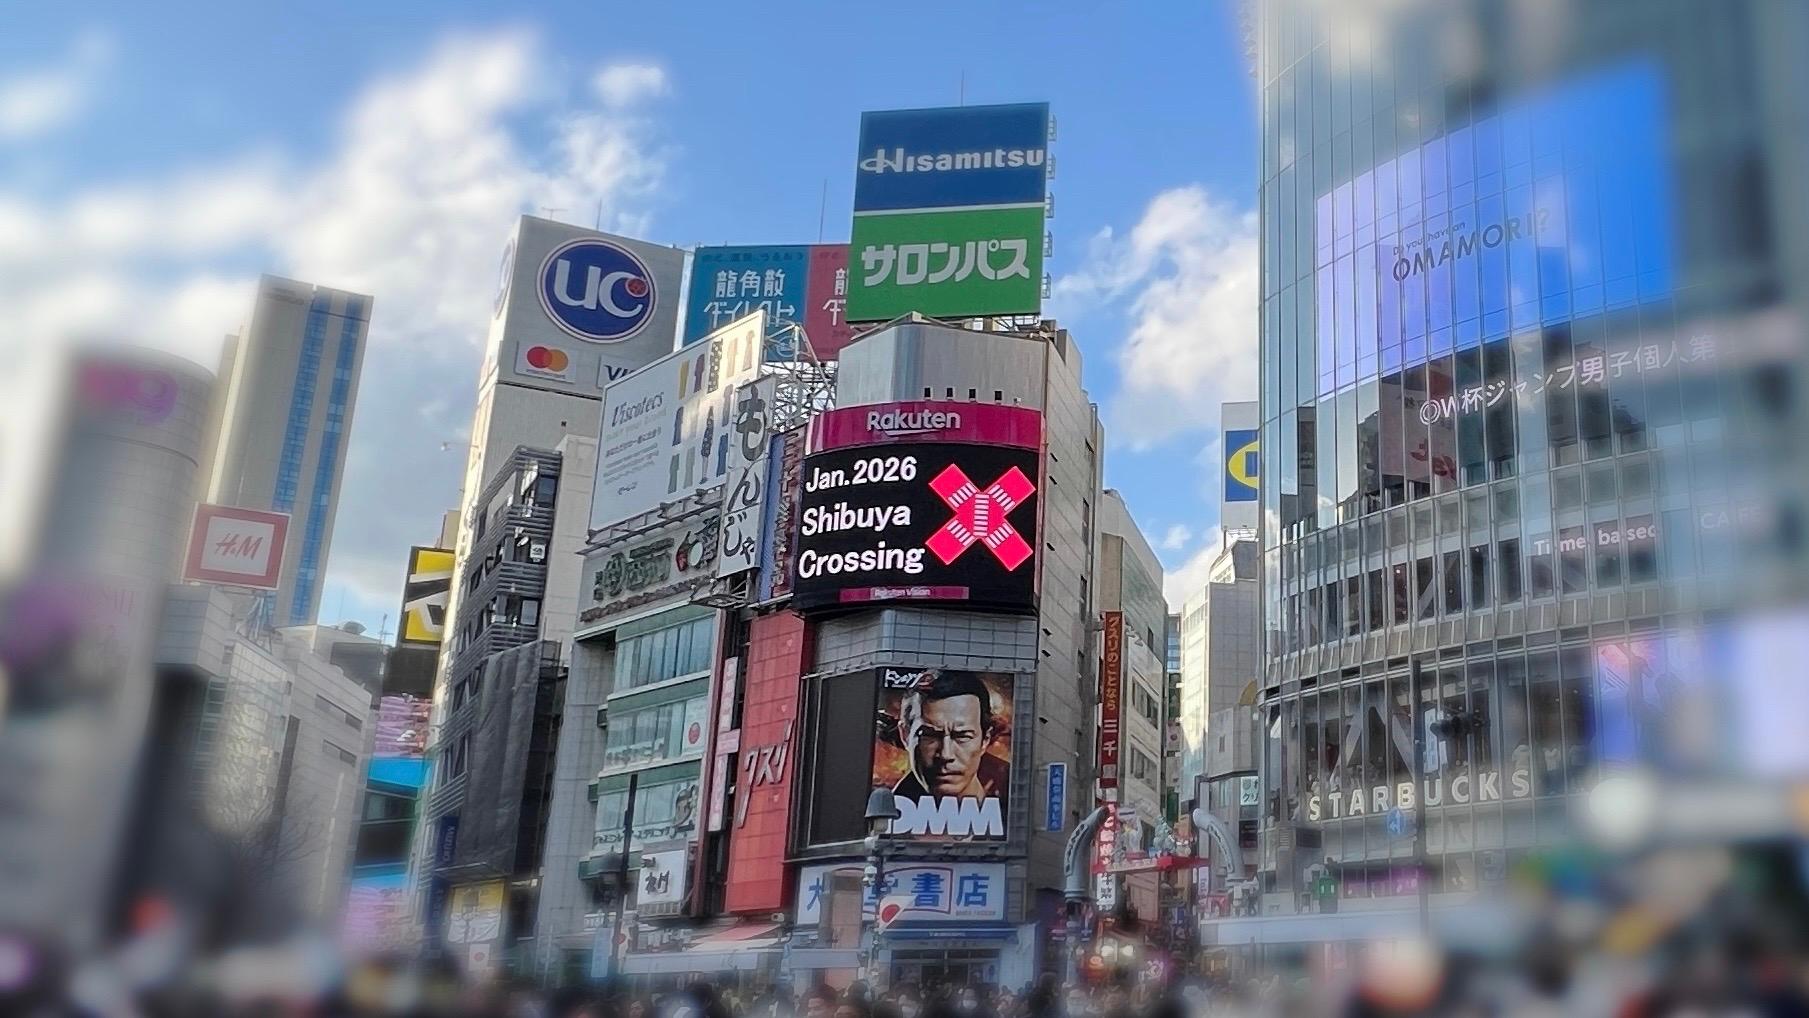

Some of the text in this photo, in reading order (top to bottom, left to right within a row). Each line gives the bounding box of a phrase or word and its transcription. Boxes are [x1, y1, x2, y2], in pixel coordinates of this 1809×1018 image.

[860, 148, 1044, 173] Hisamitsu
[861, 239, 1030, 287] サロンパス
[715, 268, 786, 298] 龍角散
[866, 410, 961, 436] Rakuten
[724, 384, 768, 565] もんじゃ
[801, 502, 911, 536] Shibuya
[215, 532, 264, 561] H&M
[798, 541, 926, 578] Crossing
[1534, 536, 1587, 555] Time
[738, 719, 796, 829] クスリ
[1309, 769, 1530, 821] STARBUCKS
[885, 795, 1004, 835] DMM
